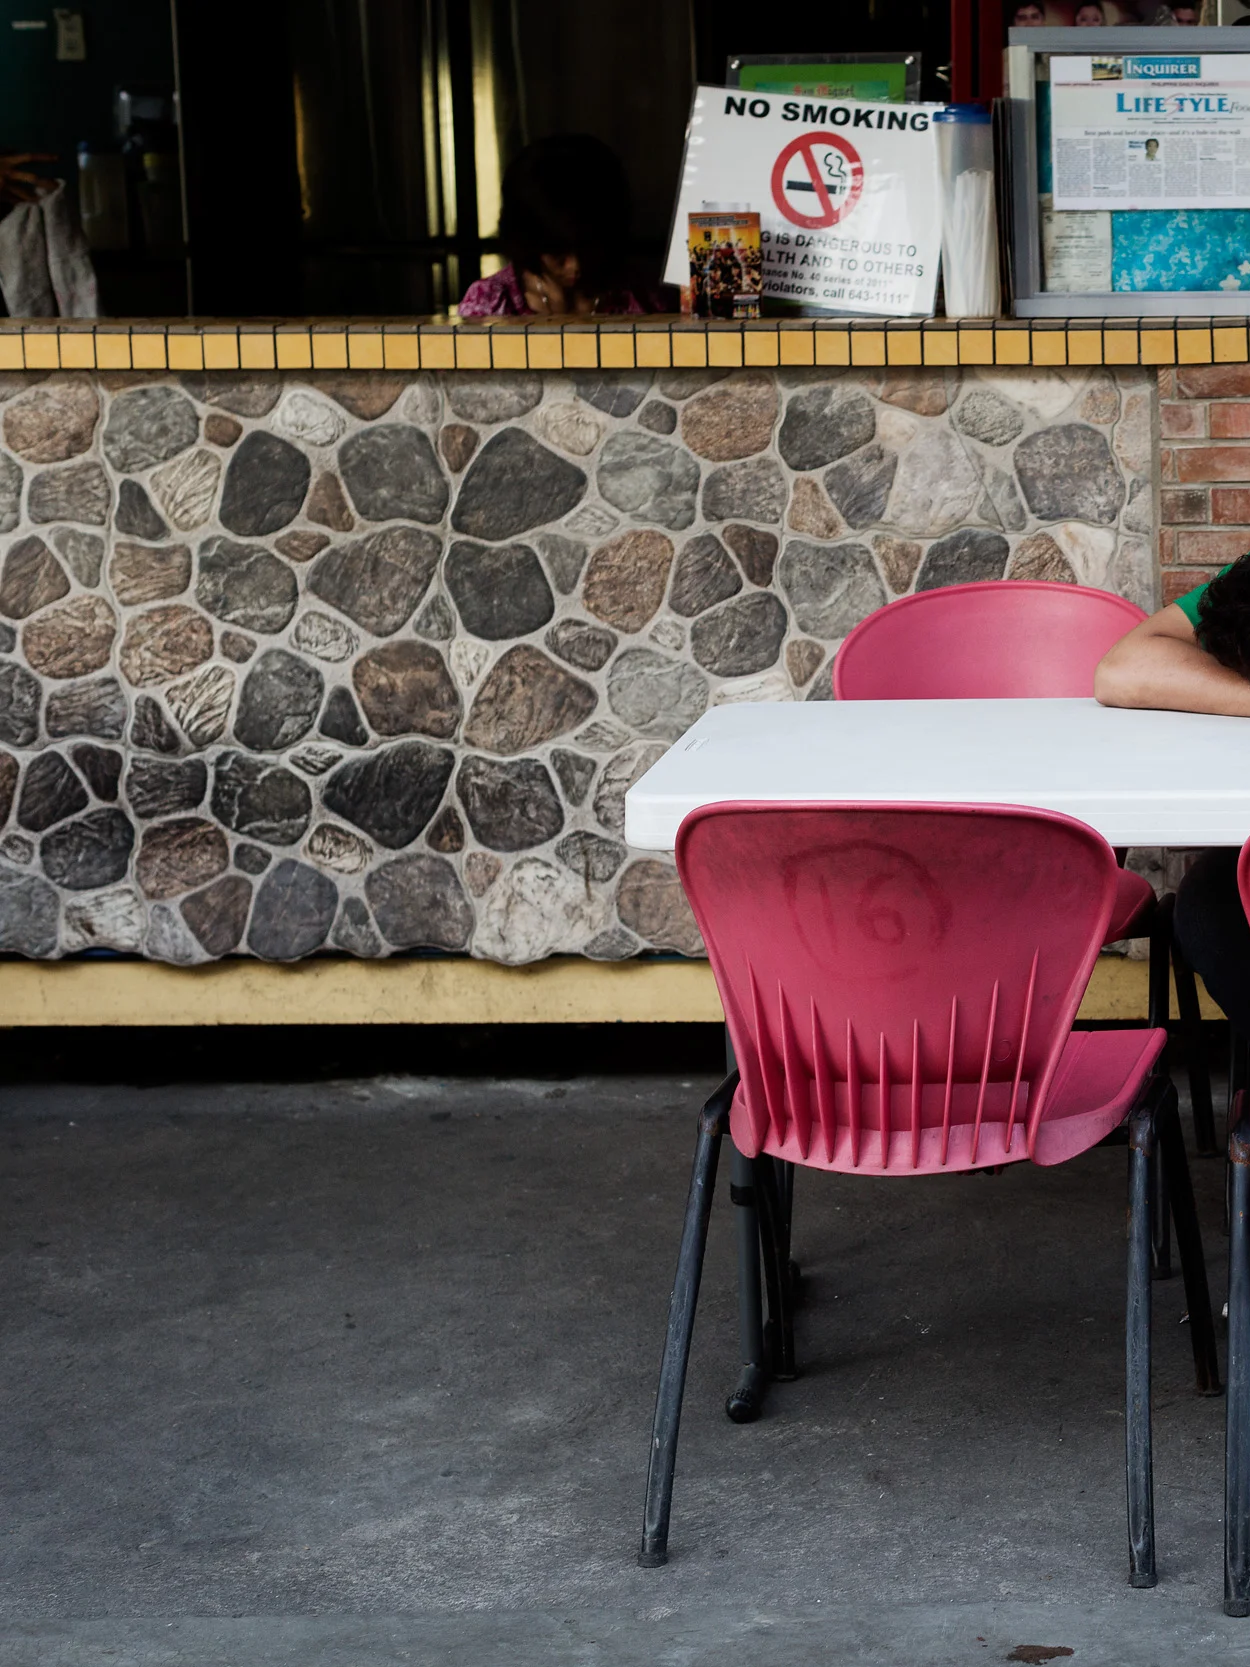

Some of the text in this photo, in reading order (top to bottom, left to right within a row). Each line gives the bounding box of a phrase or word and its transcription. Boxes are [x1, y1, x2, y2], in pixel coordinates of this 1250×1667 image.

[1126, 59, 1197, 76] INQUIRER
[724, 96, 929, 132] NO SMOKING
[775, 232, 790, 245] IS
[795, 234, 892, 255] DANGEROUS
[897, 244, 917, 257] TO
[800, 254, 832, 269] AND
[839, 258, 858, 271] TO
[863, 260, 924, 277] OTHERS
[823, 287, 845, 299] call
